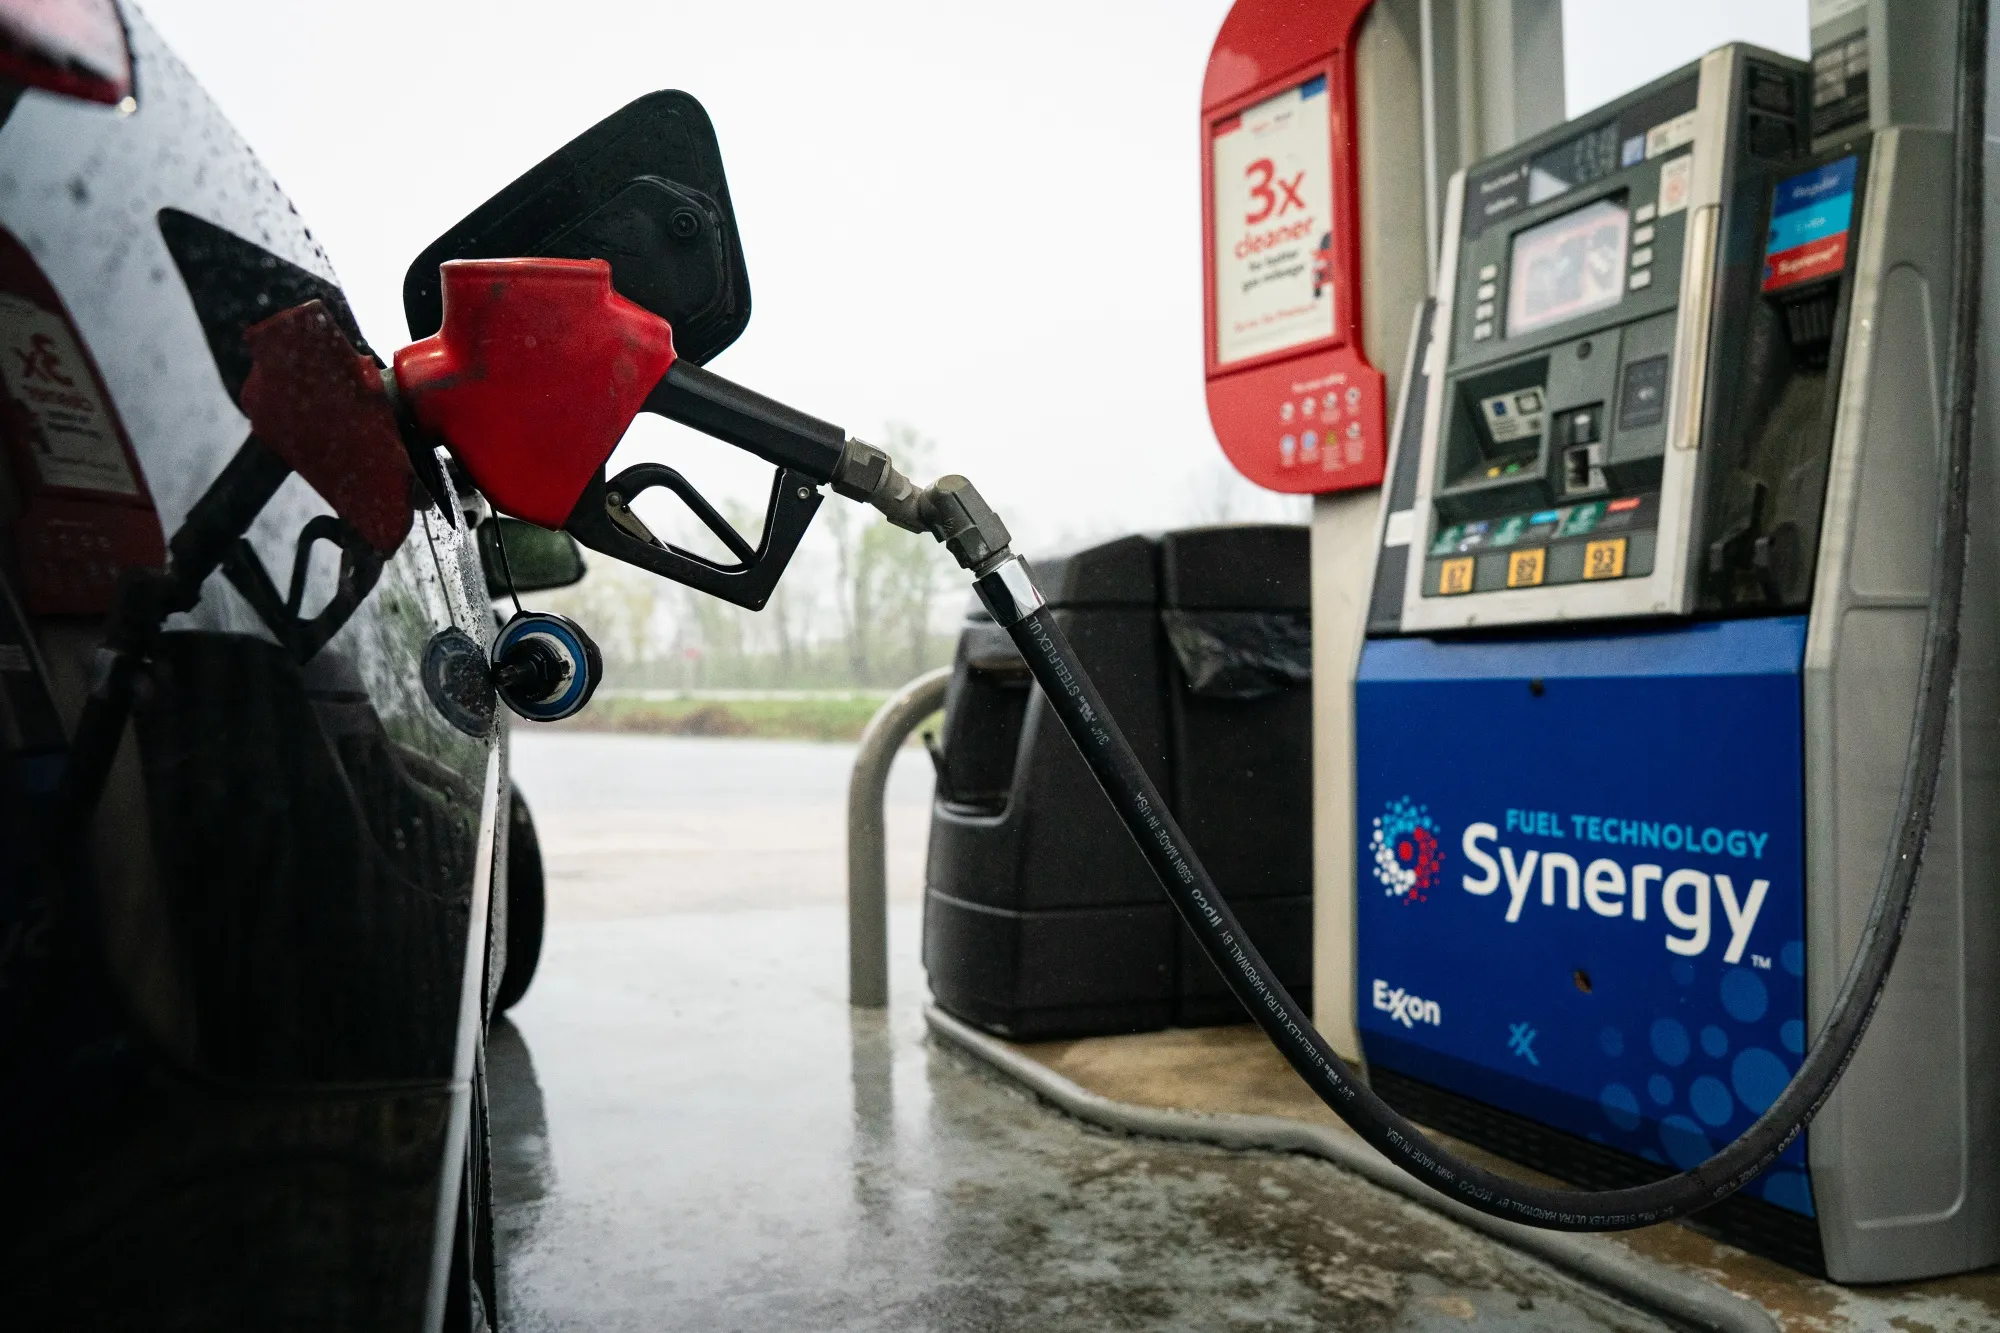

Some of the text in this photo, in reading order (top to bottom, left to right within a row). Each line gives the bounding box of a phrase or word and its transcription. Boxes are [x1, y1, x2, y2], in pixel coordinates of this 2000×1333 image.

[1245, 158, 1306, 225] 3x
[1234, 216, 1314, 259] cleaner
[1591, 547, 1616, 565] 93
[1036, 633, 1081, 697] STEELFLEX
[1133, 792, 1154, 817] USA
[1147, 816, 1161, 829] IN
[1506, 808, 1769, 858] FUEL TECHNOLOGY
[1155, 829, 1180, 859] MADE
[1462, 822, 1770, 964] Synergy
[1218, 930, 1233, 946] BY
[1230, 943, 1270, 993] HARDWALL
[1262, 992, 1289, 1022] ULTRA
[1373, 979, 1441, 1029] Exxon
[1285, 1020, 1325, 1067] STEELFLEX
[1384, 1127, 1405, 1146] USA
[1412, 1149, 1437, 1171] MADE
[1512, 1201, 1557, 1220] HARDWALL
[1559, 1213, 1586, 1224] ULTRA
[1589, 1214, 1636, 1225] STEELFLEX
